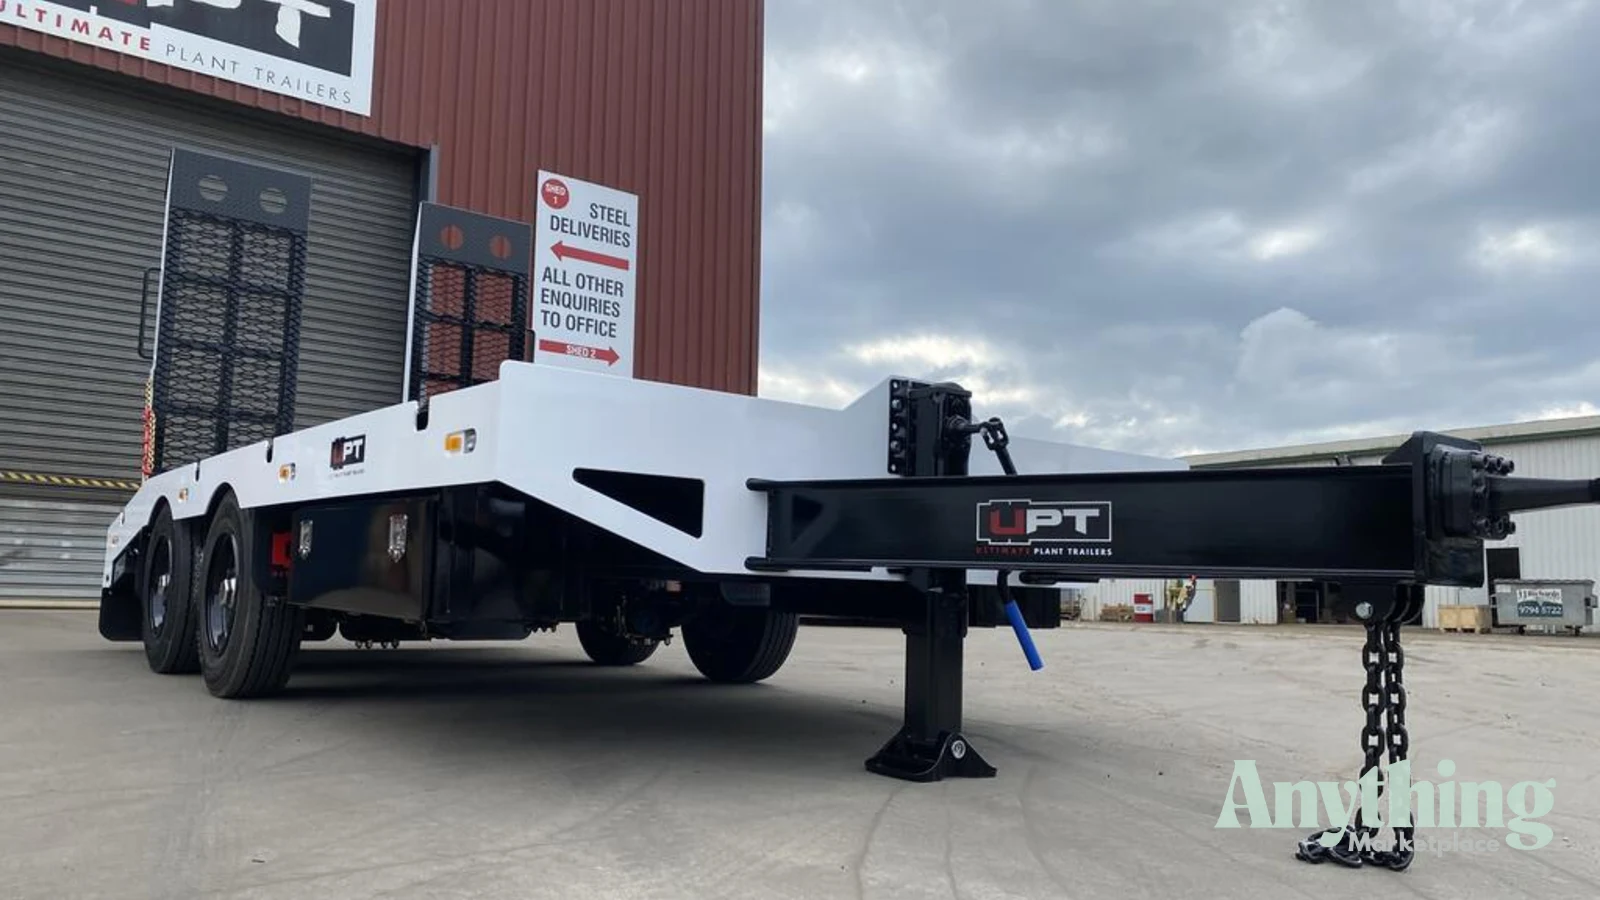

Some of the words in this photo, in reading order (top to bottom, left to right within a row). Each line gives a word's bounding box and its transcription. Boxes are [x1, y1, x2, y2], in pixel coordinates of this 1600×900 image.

[166, 44, 240, 75] PLANT
[255, 67, 351, 104] TRAILERS
[545, 182, 566, 196] SHED
[553, 196, 558, 204] 1
[590, 203, 630, 227] STEEL
[550, 215, 630, 248] DELIVERIES
[542, 266, 571, 287] ALL
[576, 273, 624, 297] OTHER
[541, 288, 620, 318] ENQUIRIES
[541, 310, 561, 328] TO
[566, 314, 617, 338] OFFICE
[566, 345, 590, 358] SHED
[590, 348, 596, 359] 2
[990, 508, 1100, 535] UPT
[1034, 547, 1063, 555] PLANT
[1068, 547, 1113, 556] TRAILERS
